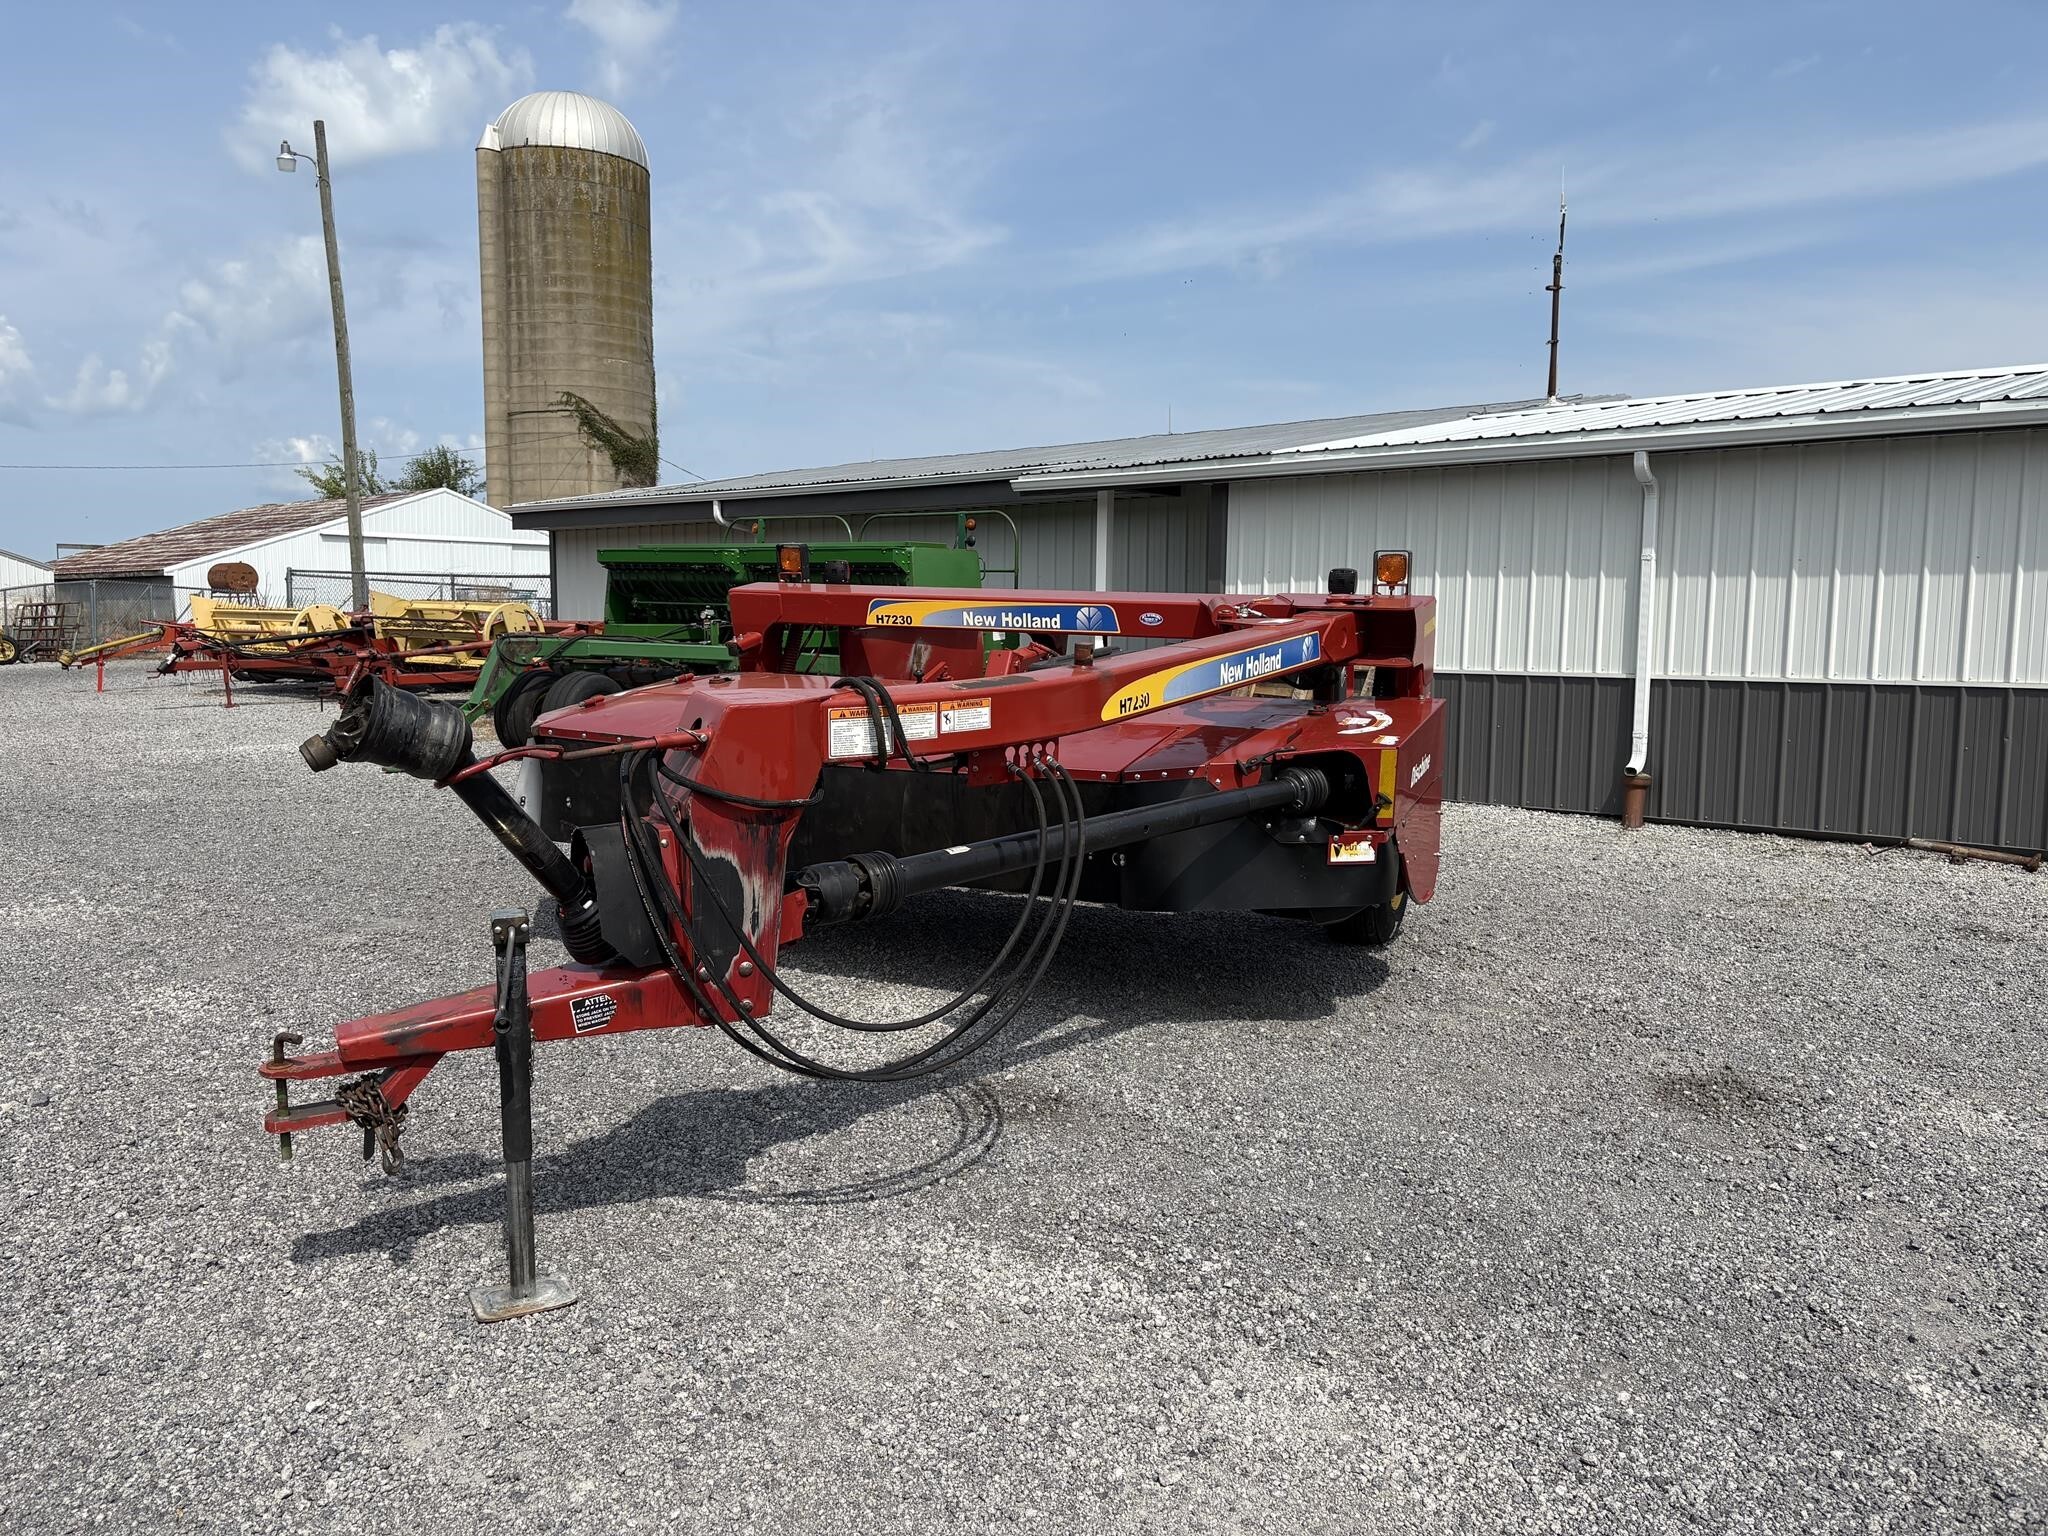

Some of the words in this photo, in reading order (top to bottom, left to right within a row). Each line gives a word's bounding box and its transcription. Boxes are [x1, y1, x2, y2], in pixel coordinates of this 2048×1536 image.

[876, 614, 912, 625] H7230
[962, 611, 996, 627] New
[1001, 612, 1061, 629] Holland
[1120, 692, 1150, 714] H7230
[1220, 662, 1244, 686] New
[1246, 648, 1281, 678] Holland
[908, 705, 933, 713] WARNING
[957, 701, 983, 709] WARNING
